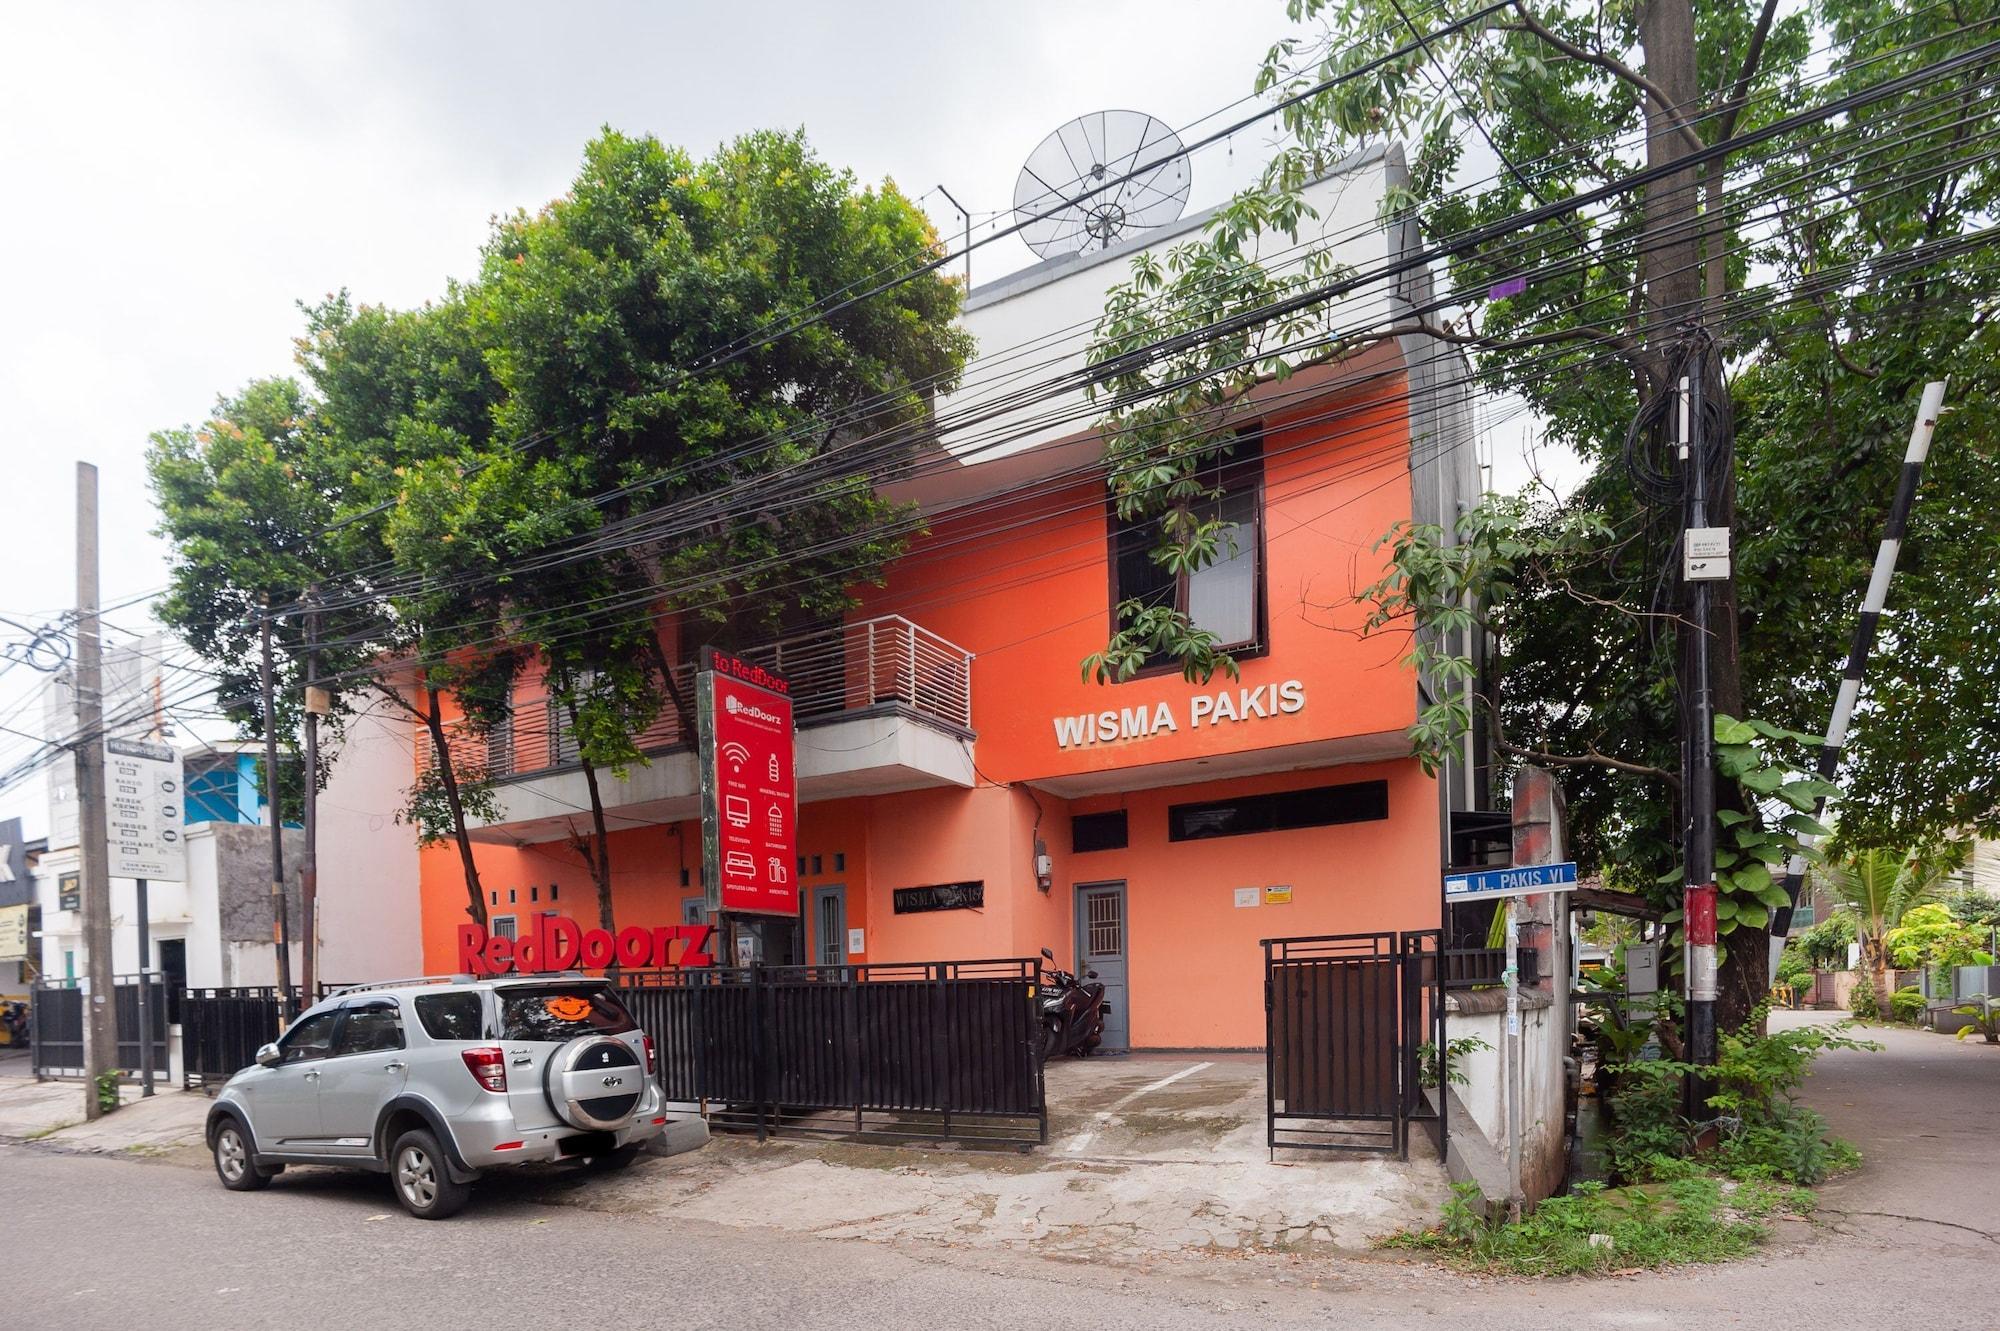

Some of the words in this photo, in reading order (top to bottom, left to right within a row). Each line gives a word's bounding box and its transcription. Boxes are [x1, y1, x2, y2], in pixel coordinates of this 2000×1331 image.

[712, 652, 729, 672] to
[732, 658, 790, 693] RedDoor
[737, 701, 782, 725] RedDoorz
[1053, 702, 1177, 747] WISMA
[1190, 680, 1305, 728] PAKIS
[1476, 876, 1494, 891] JL.
[1500, 870, 1542, 889] PAKIS
[1549, 868, 1563, 884] VI
[895, 890, 938, 908] WISMA
[458, 912, 715, 974] RedDoorz
